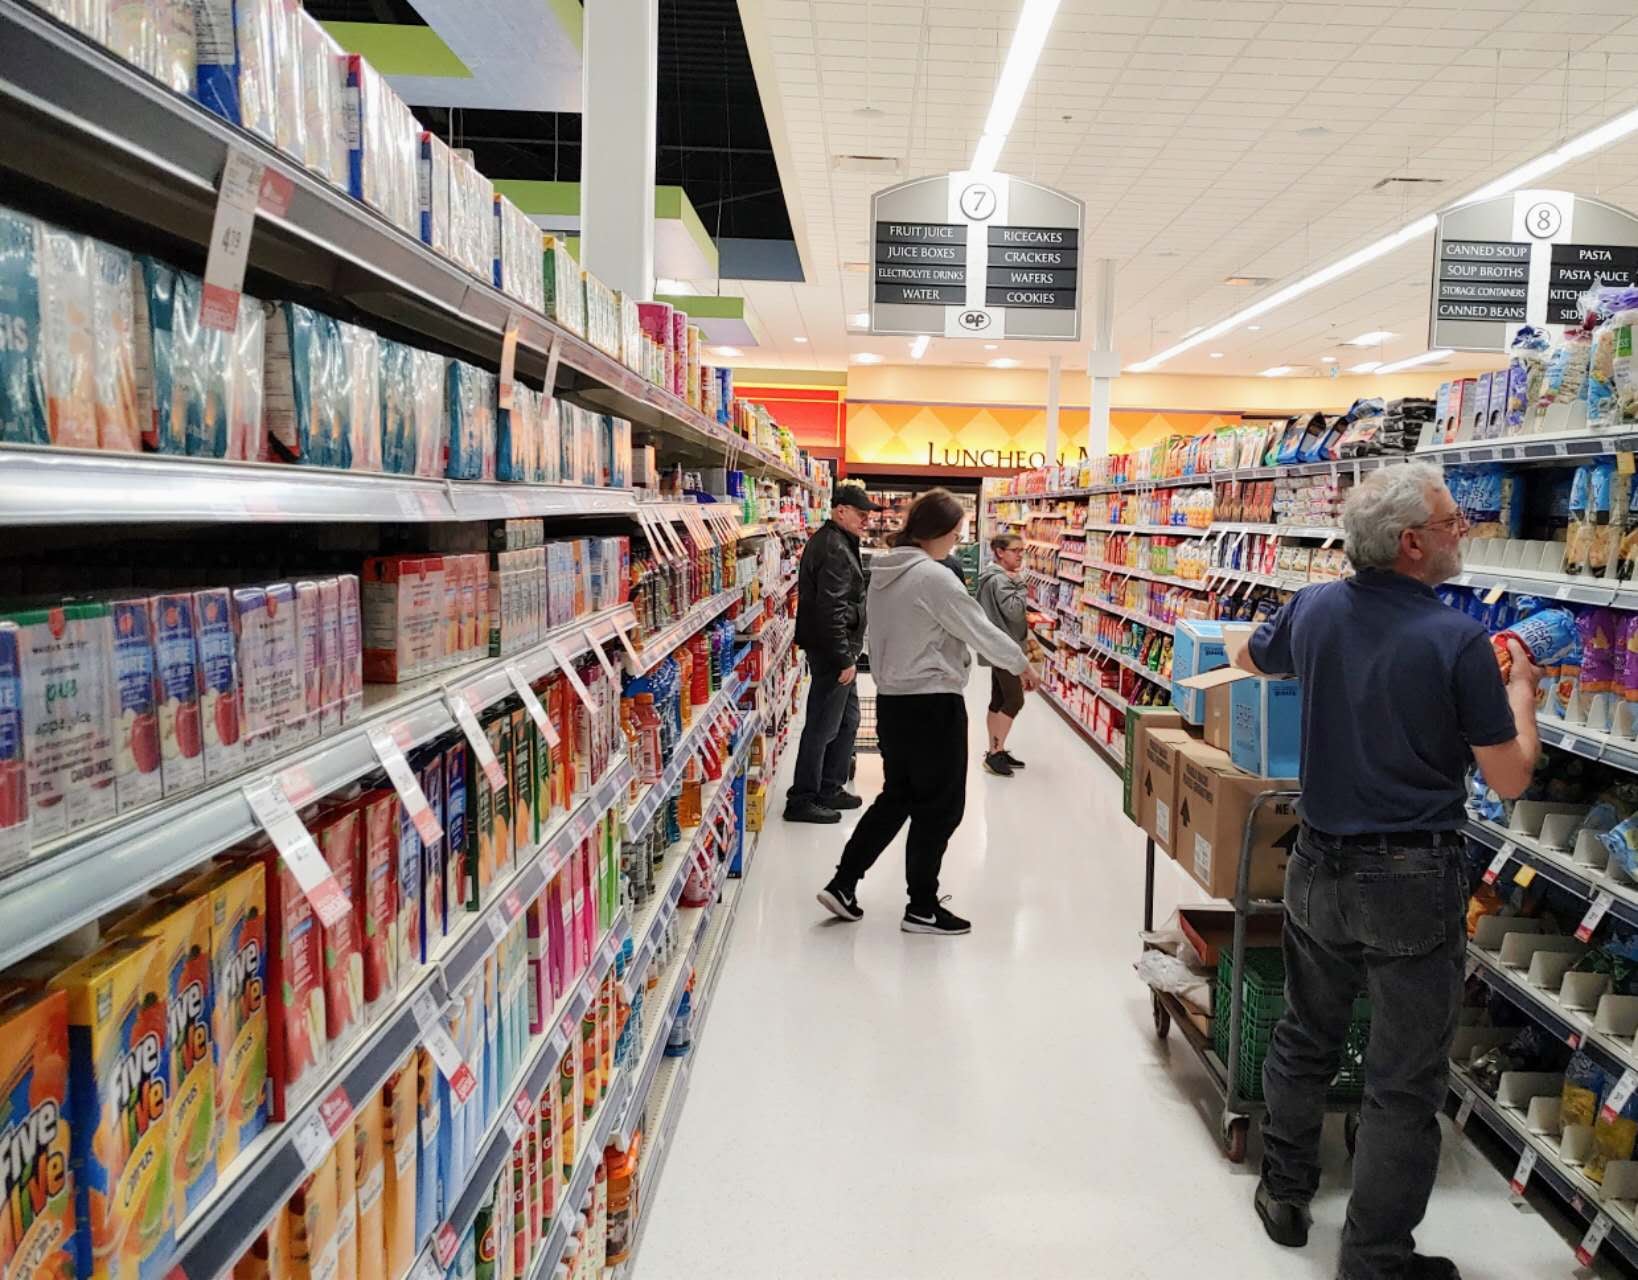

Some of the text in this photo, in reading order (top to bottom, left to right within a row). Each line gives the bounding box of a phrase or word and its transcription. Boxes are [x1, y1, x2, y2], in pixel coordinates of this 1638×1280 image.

[973, 191, 986, 211] 7
[1537, 209, 1551, 231] 8
[889, 225, 954, 239] FRUIT JUICE
[1003, 231, 1063, 243] RICECAKES
[887, 246, 955, 259] JUICE BOXES
[1446, 244, 1528, 257] CANNED SOUP
[1578, 250, 1612, 261] PASTA
[1004, 251, 1061, 263] CRACKERS
[878, 268, 964, 280] ELECTROLYTE DRINKS
[1447, 265, 1524, 278] SOUP BROTHS
[1559, 269, 1629, 282] PASTA SAUCE
[1010, 272, 1054, 284] WAFERS
[902, 289, 940, 300] WATER
[1006, 292, 1055, 304] COOKIES
[1441, 287, 1525, 298] STORAGE CONTAINERS
[1439, 305, 1525, 319] CANNED BEANS
